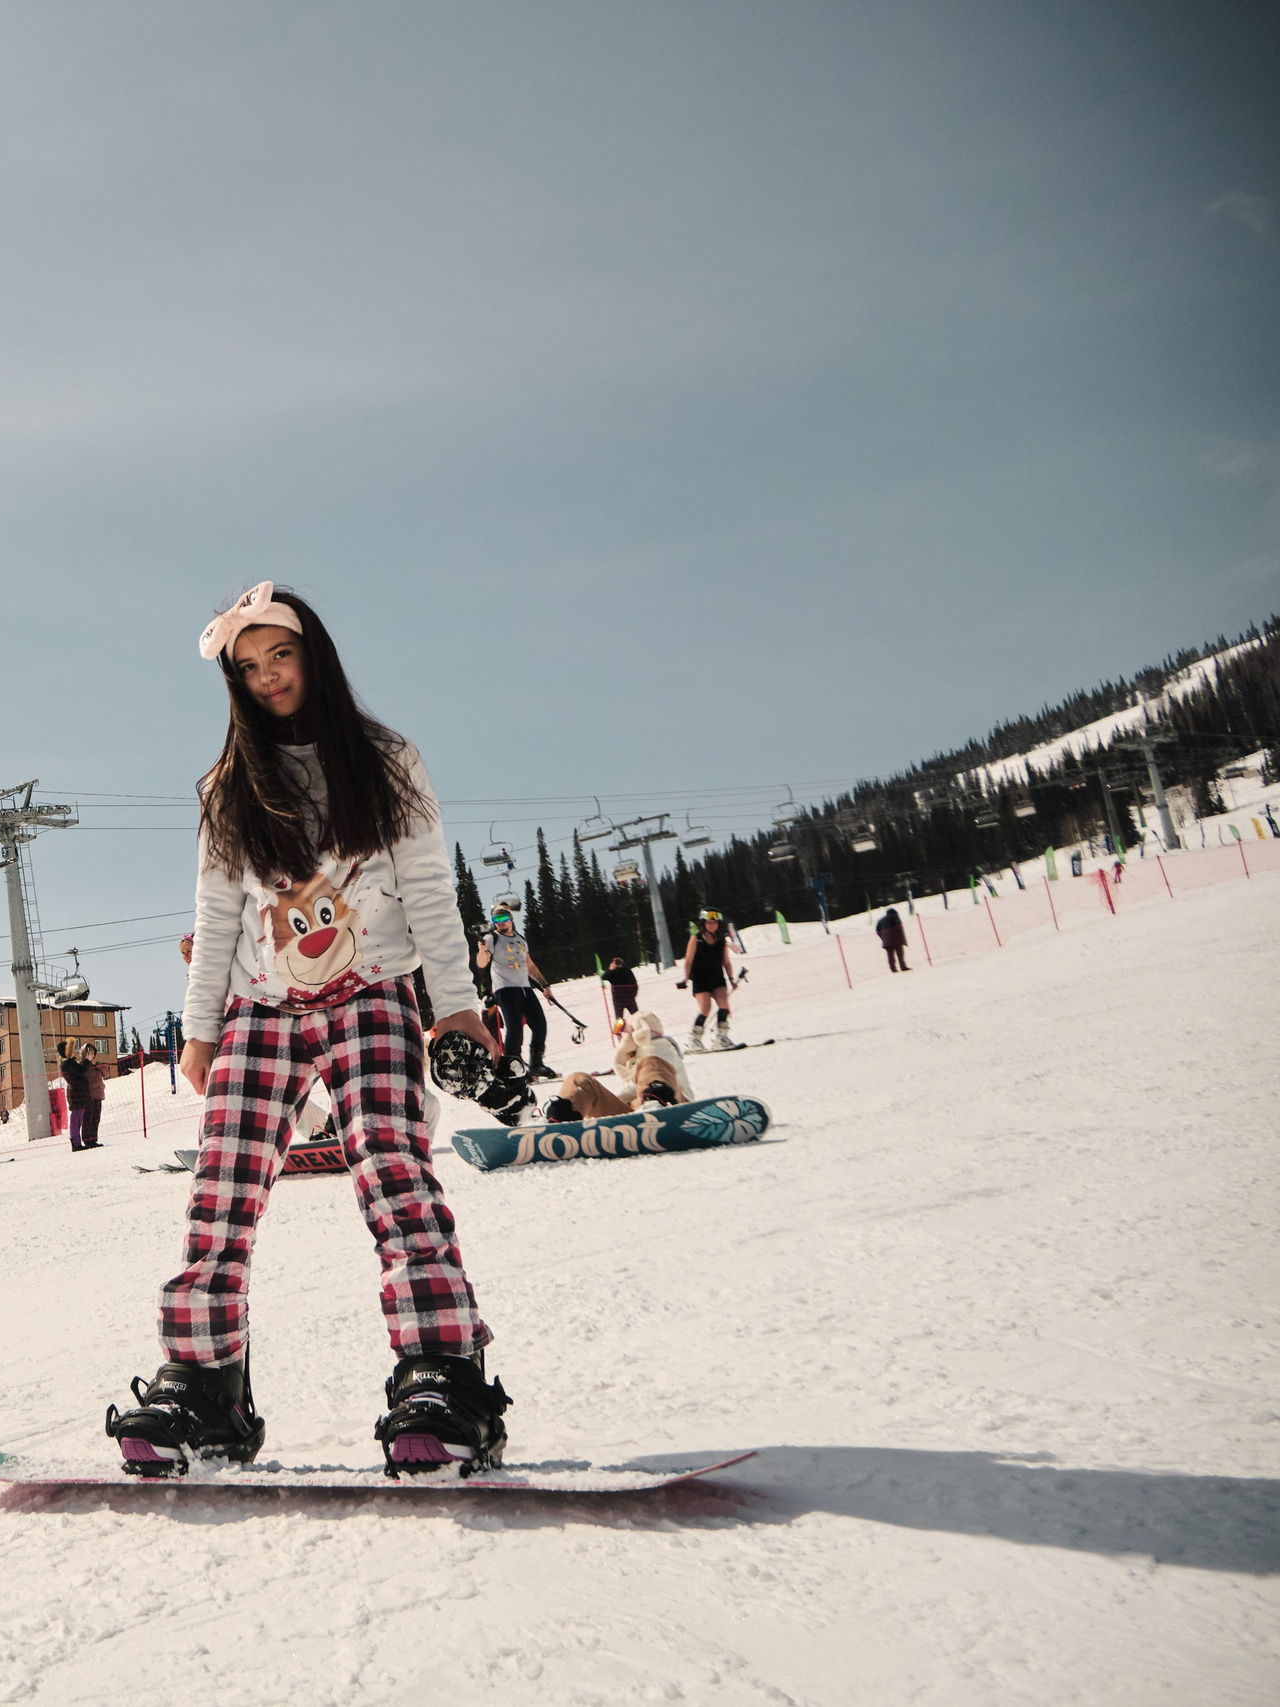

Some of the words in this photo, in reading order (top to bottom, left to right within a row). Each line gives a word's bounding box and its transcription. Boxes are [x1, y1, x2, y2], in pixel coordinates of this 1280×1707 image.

[505, 1112, 668, 1166] Joint
[412, 1369, 442, 1384] NITR
[159, 1377, 187, 1394] NITRO
